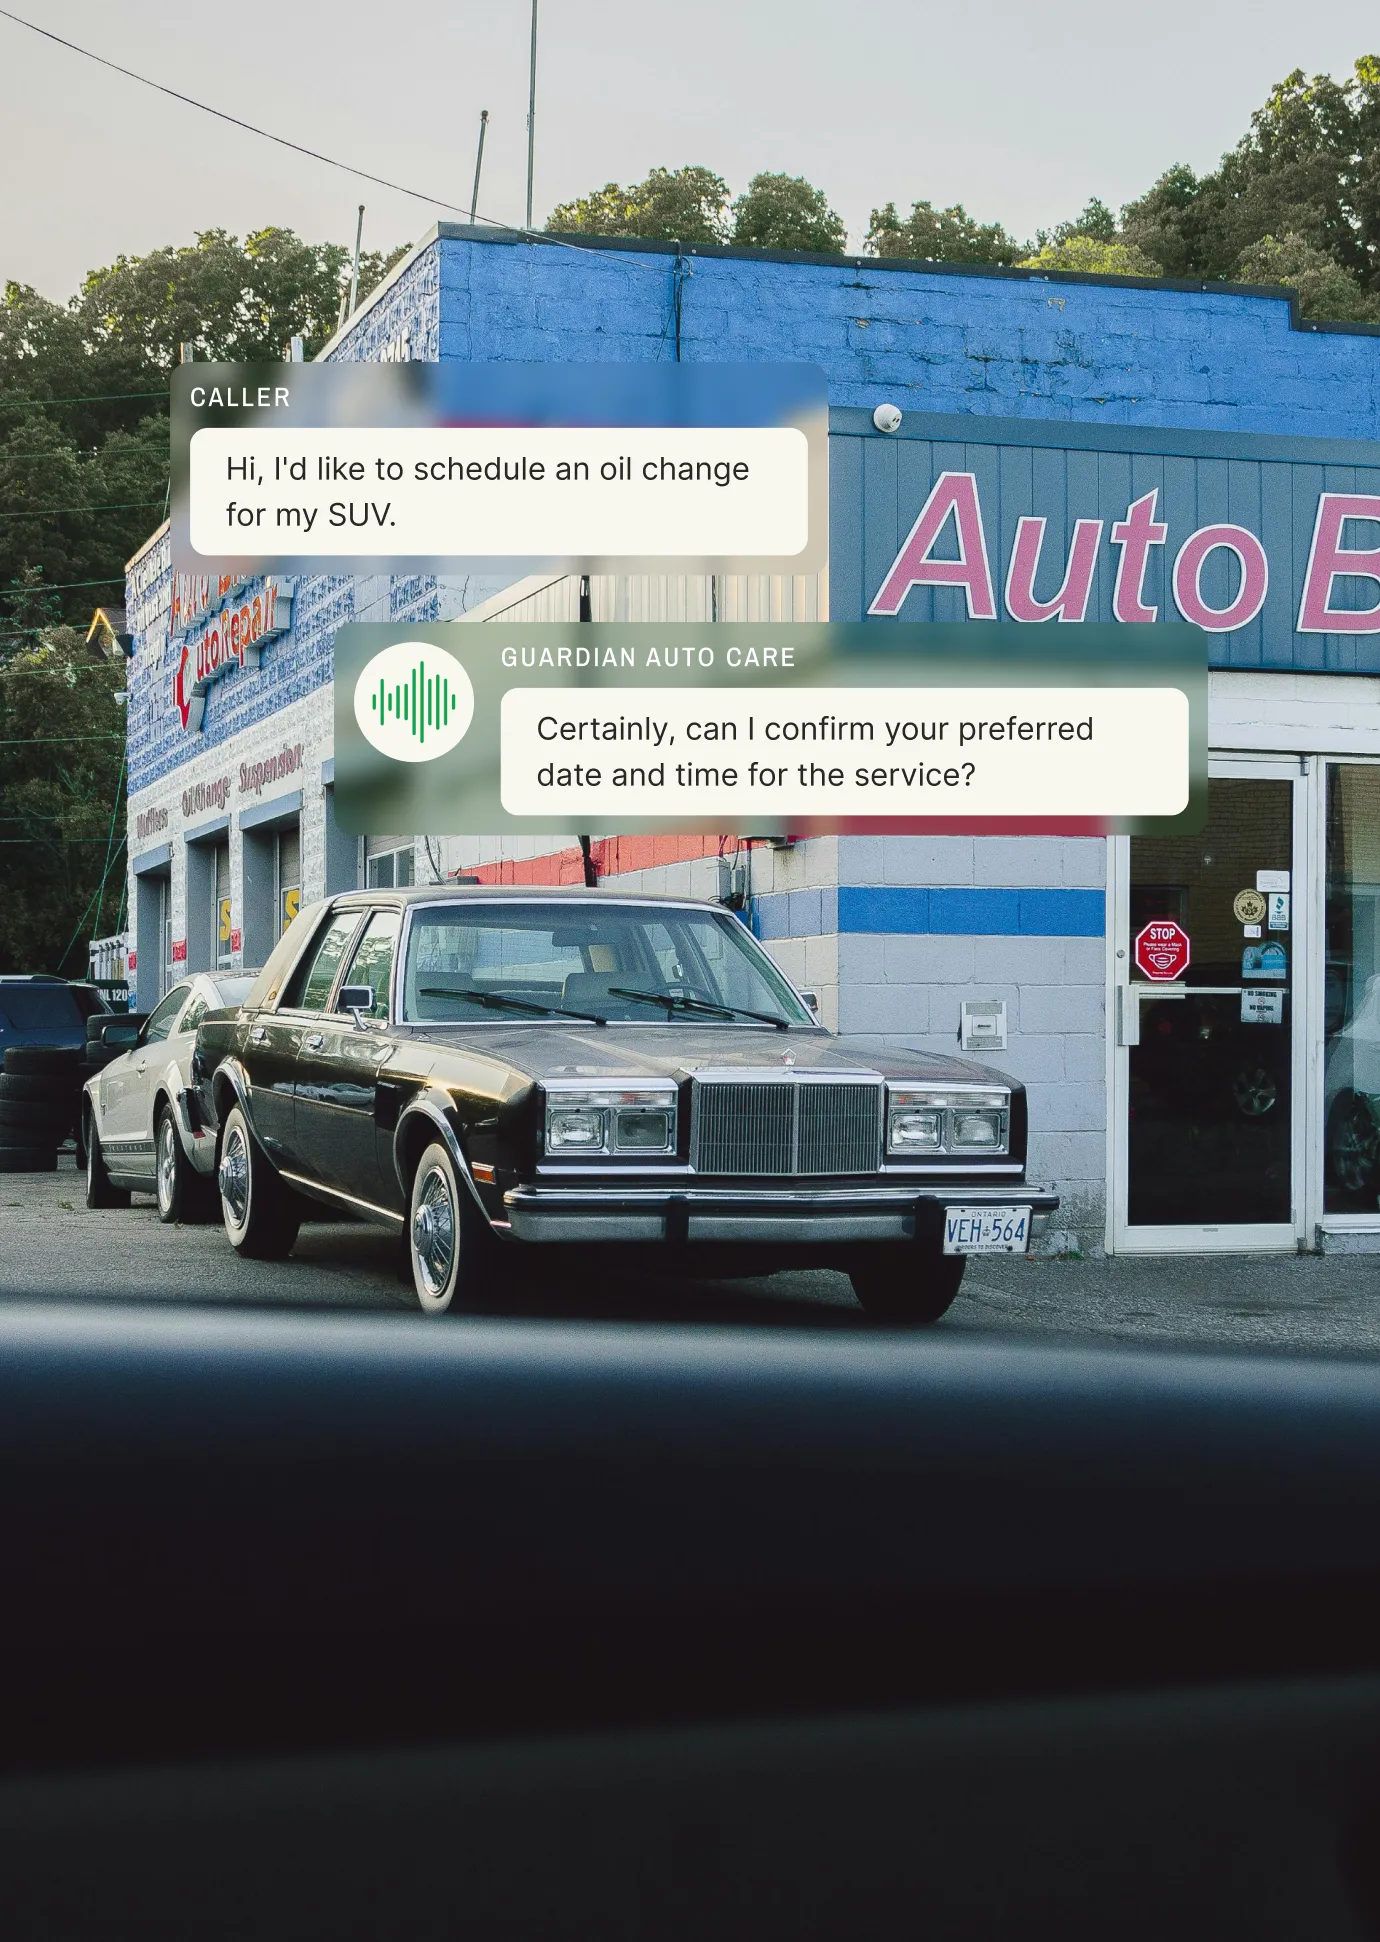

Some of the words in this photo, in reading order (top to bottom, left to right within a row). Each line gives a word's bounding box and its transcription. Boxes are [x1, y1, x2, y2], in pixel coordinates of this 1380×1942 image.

[867, 471, 1268, 632] Auto
[239, 743, 303, 796] Suspension
[1150, 928, 1176, 940] STOP
[112, 988, 127, 1001] 120
[947, 1219, 982, 1242] VEH
[991, 1218, 1025, 1242] 564
